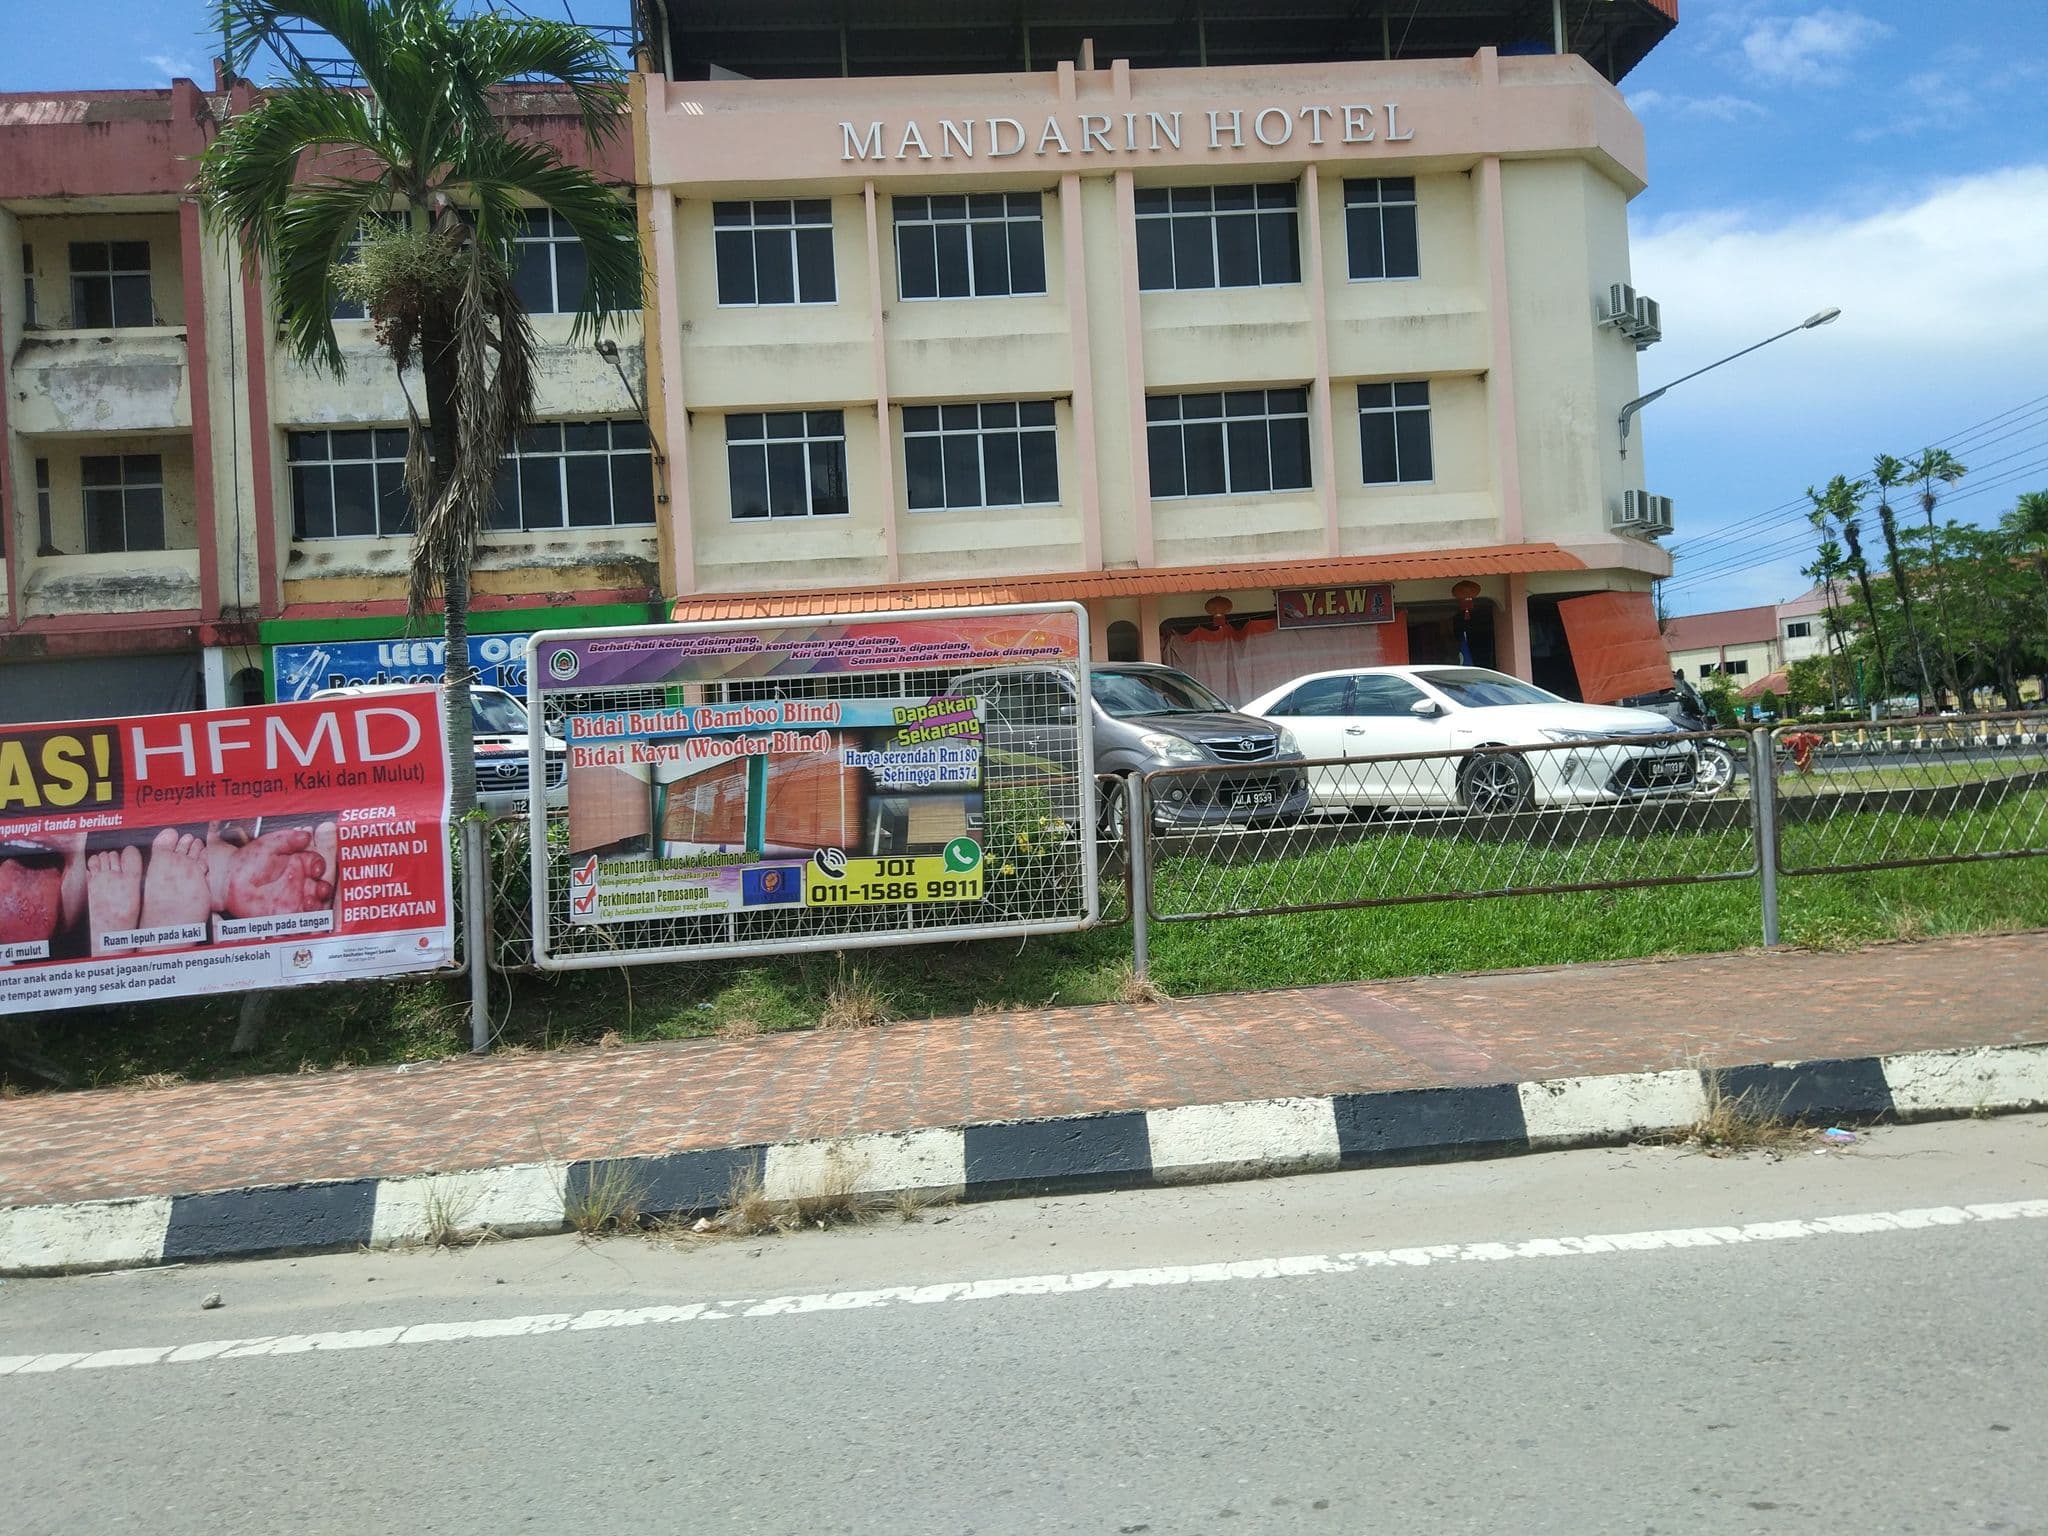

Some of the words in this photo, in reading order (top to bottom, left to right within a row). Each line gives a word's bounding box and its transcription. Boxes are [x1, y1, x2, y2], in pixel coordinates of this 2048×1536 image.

[838, 111, 1183, 161] MANDARIN
[1205, 103, 1416, 148] HOTEL
[1302, 589, 1367, 616] Y.E.W
[589, 639, 656, 652] Berhati-hati
[658, 638, 695, 649] keluar
[697, 636, 760, 647] disimpang.
[683, 646, 731, 656] Pastikan
[734, 644, 763, 652] tiada
[765, 641, 825, 651] kenderaan
[828, 640, 856, 648] yang
[858, 636, 900, 646] datang,
[791, 650, 811, 659] Kiri
[813, 649, 835, 657] dan
[837, 648, 872, 656] kanan
[874, 645, 907, 653] harus
[909, 642, 971, 652] dipandang,
[850, 655, 896, 665] Semasa
[898, 653, 942, 662] hendak
[942, 650, 999, 660] membelok
[1002, 646, 1063, 656] disimpang.
[572, 716, 624, 739] Bidai
[629, 709, 689, 733] Buluh
[693, 704, 778, 732] (Bamboo
[783, 701, 842, 726] Blind)
[893, 695, 977, 725] Dapatkan
[896, 717, 980, 747] Sekarang
[0, 734, 113, 809] AS!
[131, 706, 422, 781] HFMD
[573, 744, 625, 768] Bidai
[630, 742, 680, 766] Kayu
[685, 736, 768, 761] (Wooden
[773, 730, 832, 755] Blind)
[845, 749, 881, 768] Harga
[883, 749, 937, 765] serendah
[939, 747, 978, 763] Rm180
[136, 778, 216, 807] (Penyakit
[222, 777, 289, 799] Tangan,
[294, 770, 331, 789] Kaki
[336, 769, 367, 788] dan
[372, 763, 425, 783] Mulut)
[883, 766, 937, 785] Sehingga
[939, 765, 978, 781] Rm374
[44, 817, 77, 832] tanda
[79, 813, 123, 829] berikut:
[341, 805, 397, 821] SEGERA
[339, 820, 417, 840] DAPATKAN
[341, 841, 410, 861] RAWATAN
[412, 839, 428, 855] DI
[342, 863, 394, 881] KLINIK/
[597, 857, 660, 877] Penghantaran
[874, 859, 916, 877] JOI
[343, 882, 412, 902] HOSPITAL
[598, 890, 656, 907] Perkhidmatan
[657, 887, 709, 903] Pemasangan
[811, 881, 918, 902] 011-1586
[926, 879, 978, 899] 9911
[344, 900, 437, 922] BERDEKATAN
[221, 925, 247, 935] Ruam
[249, 921, 273, 934] lepuh
[275, 918, 297, 933] pada
[299, 916, 330, 929] tangan
[103, 935, 129, 946] Ruam
[131, 931, 155, 945] lepuh
[158, 929, 180, 943] pada
[182, 926, 202, 938] kaki
[5, 947, 14, 958] di
[16, 945, 42, 957] mulut
[23, 972, 47, 984] anak
[48, 970, 73, 981] anda
[74, 968, 86, 979] ke
[87, 966, 115, 980] pusat
[115, 957, 184, 977] jagaan/rumah
[185, 949, 271, 970] pengasuh/sekolah
[8, 989, 42, 1001] tempat
[43, 986, 73, 998] awam
[74, 984, 97, 996] yang
[99, 980, 126, 992] sesak
[128, 977, 147, 988] dan
[148, 974, 176, 991] padat
